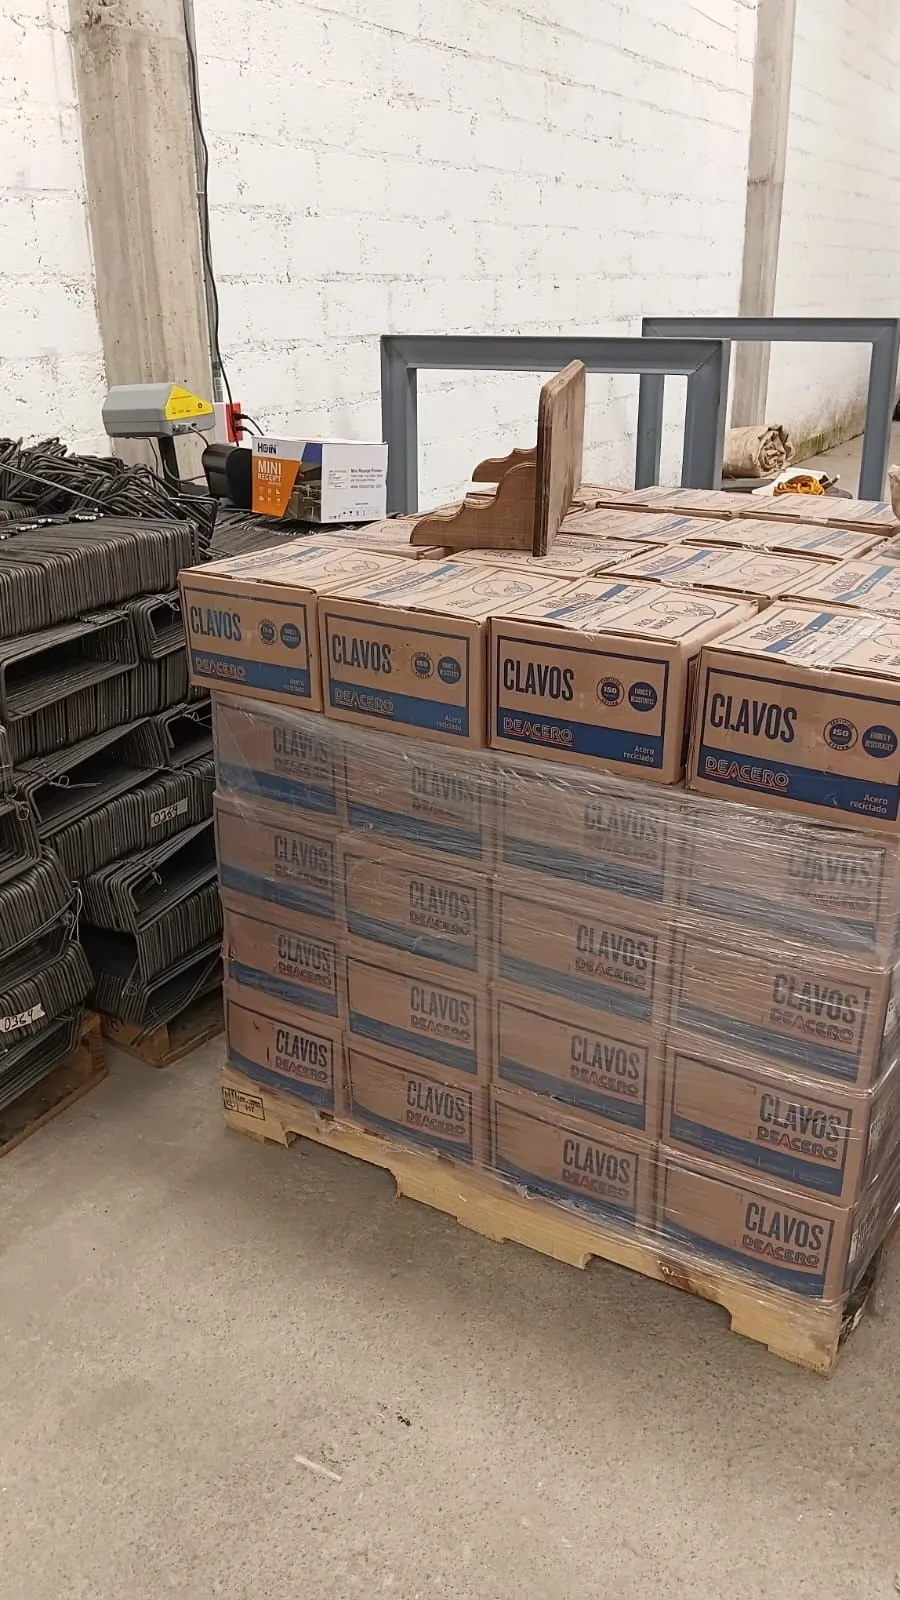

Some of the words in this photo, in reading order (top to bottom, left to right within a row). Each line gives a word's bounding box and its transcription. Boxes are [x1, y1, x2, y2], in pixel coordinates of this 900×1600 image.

[257, 460, 281, 475] MINI
[190, 605, 242, 642] CLAVOS
[195, 656, 246, 680] DEACERO
[331, 633, 393, 674] CLAVOS
[503, 658, 575, 702] CLAVOS
[604, 686, 617, 694] ISO
[334, 687, 394, 713] DEACERO
[503, 716, 573, 745] DEACERO
[709, 693, 798, 744] CLAVOS
[832, 728, 849, 737] ISO
[623, 752, 655, 763] reciclado
[634, 745, 655, 755] Acero
[705, 755, 790, 789] DEACERO
[153, 803, 178, 825] 0364
[849, 800, 887, 814] reciclado
[863, 794, 888, 805] Acero
[273, 835, 329, 875] CLAVOS
[408, 880, 471, 922] CLAVOS
[277, 934, 331, 972] CLAVOS
[576, 924, 649, 971] CLAVOS
[575, 958, 647, 988] DEACERO
[409, 985, 470, 1027] CLAVOS
[772, 973, 858, 1024] CLAVOS
[4, 1008, 34, 1031] 0364
[409, 1014, 471, 1041] DEACERO
[769, 1007, 854, 1043] DEACERO
[275, 1028, 328, 1068] CLAVOS
[570, 1034, 641, 1081] CLAVOS
[275, 1058, 329, 1081] DEACERO
[570, 1065, 639, 1096] DEACERO
[406, 1080, 466, 1122] CLAVOS
[759, 1092, 842, 1142] CLAVOS
[405, 1110, 466, 1135] DEACERO
[757, 1126, 838, 1160] DEACERO
[562, 1138, 631, 1185] CLAVOS
[562, 1168, 630, 1199] DEACERO
[744, 1202, 824, 1251] CLAVOS
[742, 1233, 820, 1266] DEACERO
